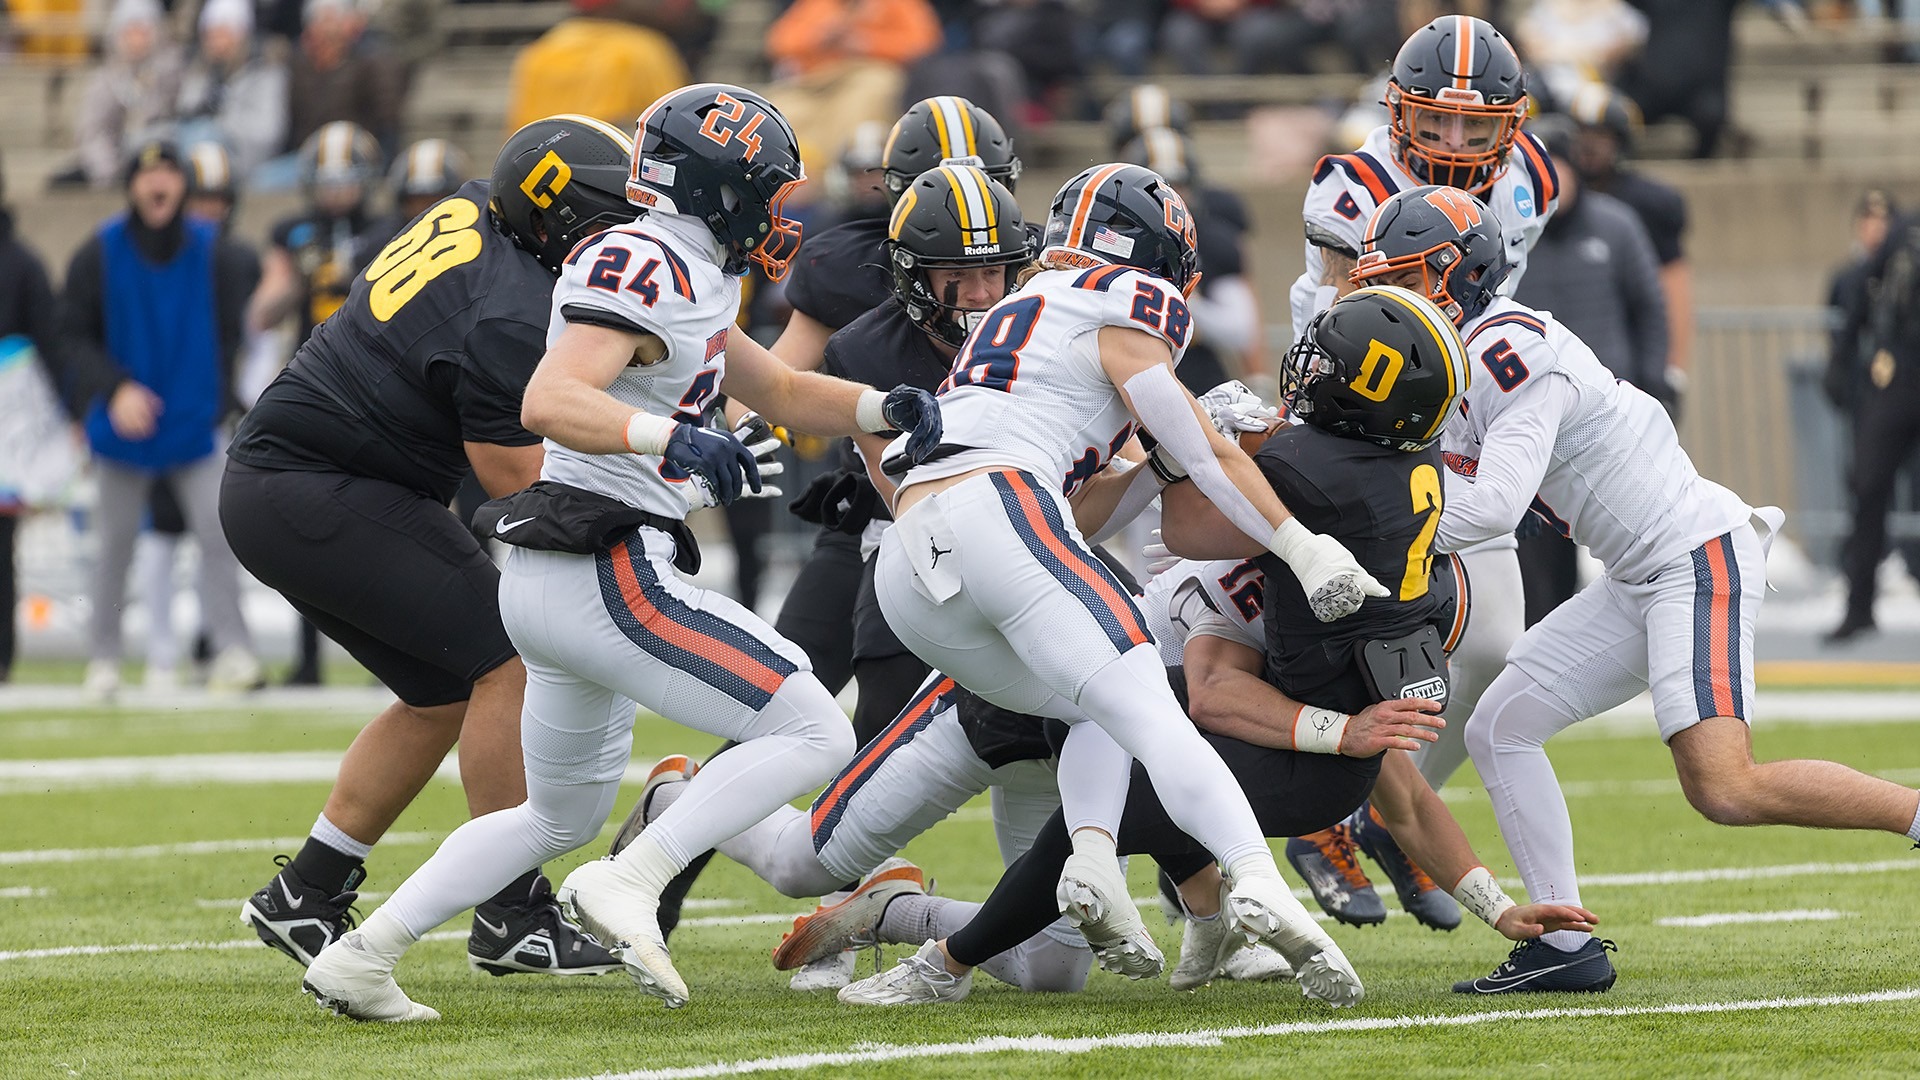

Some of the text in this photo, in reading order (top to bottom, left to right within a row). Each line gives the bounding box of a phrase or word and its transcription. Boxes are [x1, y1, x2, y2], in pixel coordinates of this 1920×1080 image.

[698, 92, 767, 162] 24
[1422, 186, 1482, 236] W
[365, 197, 483, 323] 68
[586, 246, 662, 309] 24
[964, 244, 1001, 256] Riddell
[935, 293, 1046, 398] 8
[1130, 279, 1191, 349] 28
[1349, 338, 1405, 402] D
[1481, 337, 1531, 394] 6
[1394, 420, 1405, 430] 2
[1398, 464, 1444, 602] 2
[1404, 681, 1444, 700] BATTLE
[520, 945, 548, 956] ALPHA
